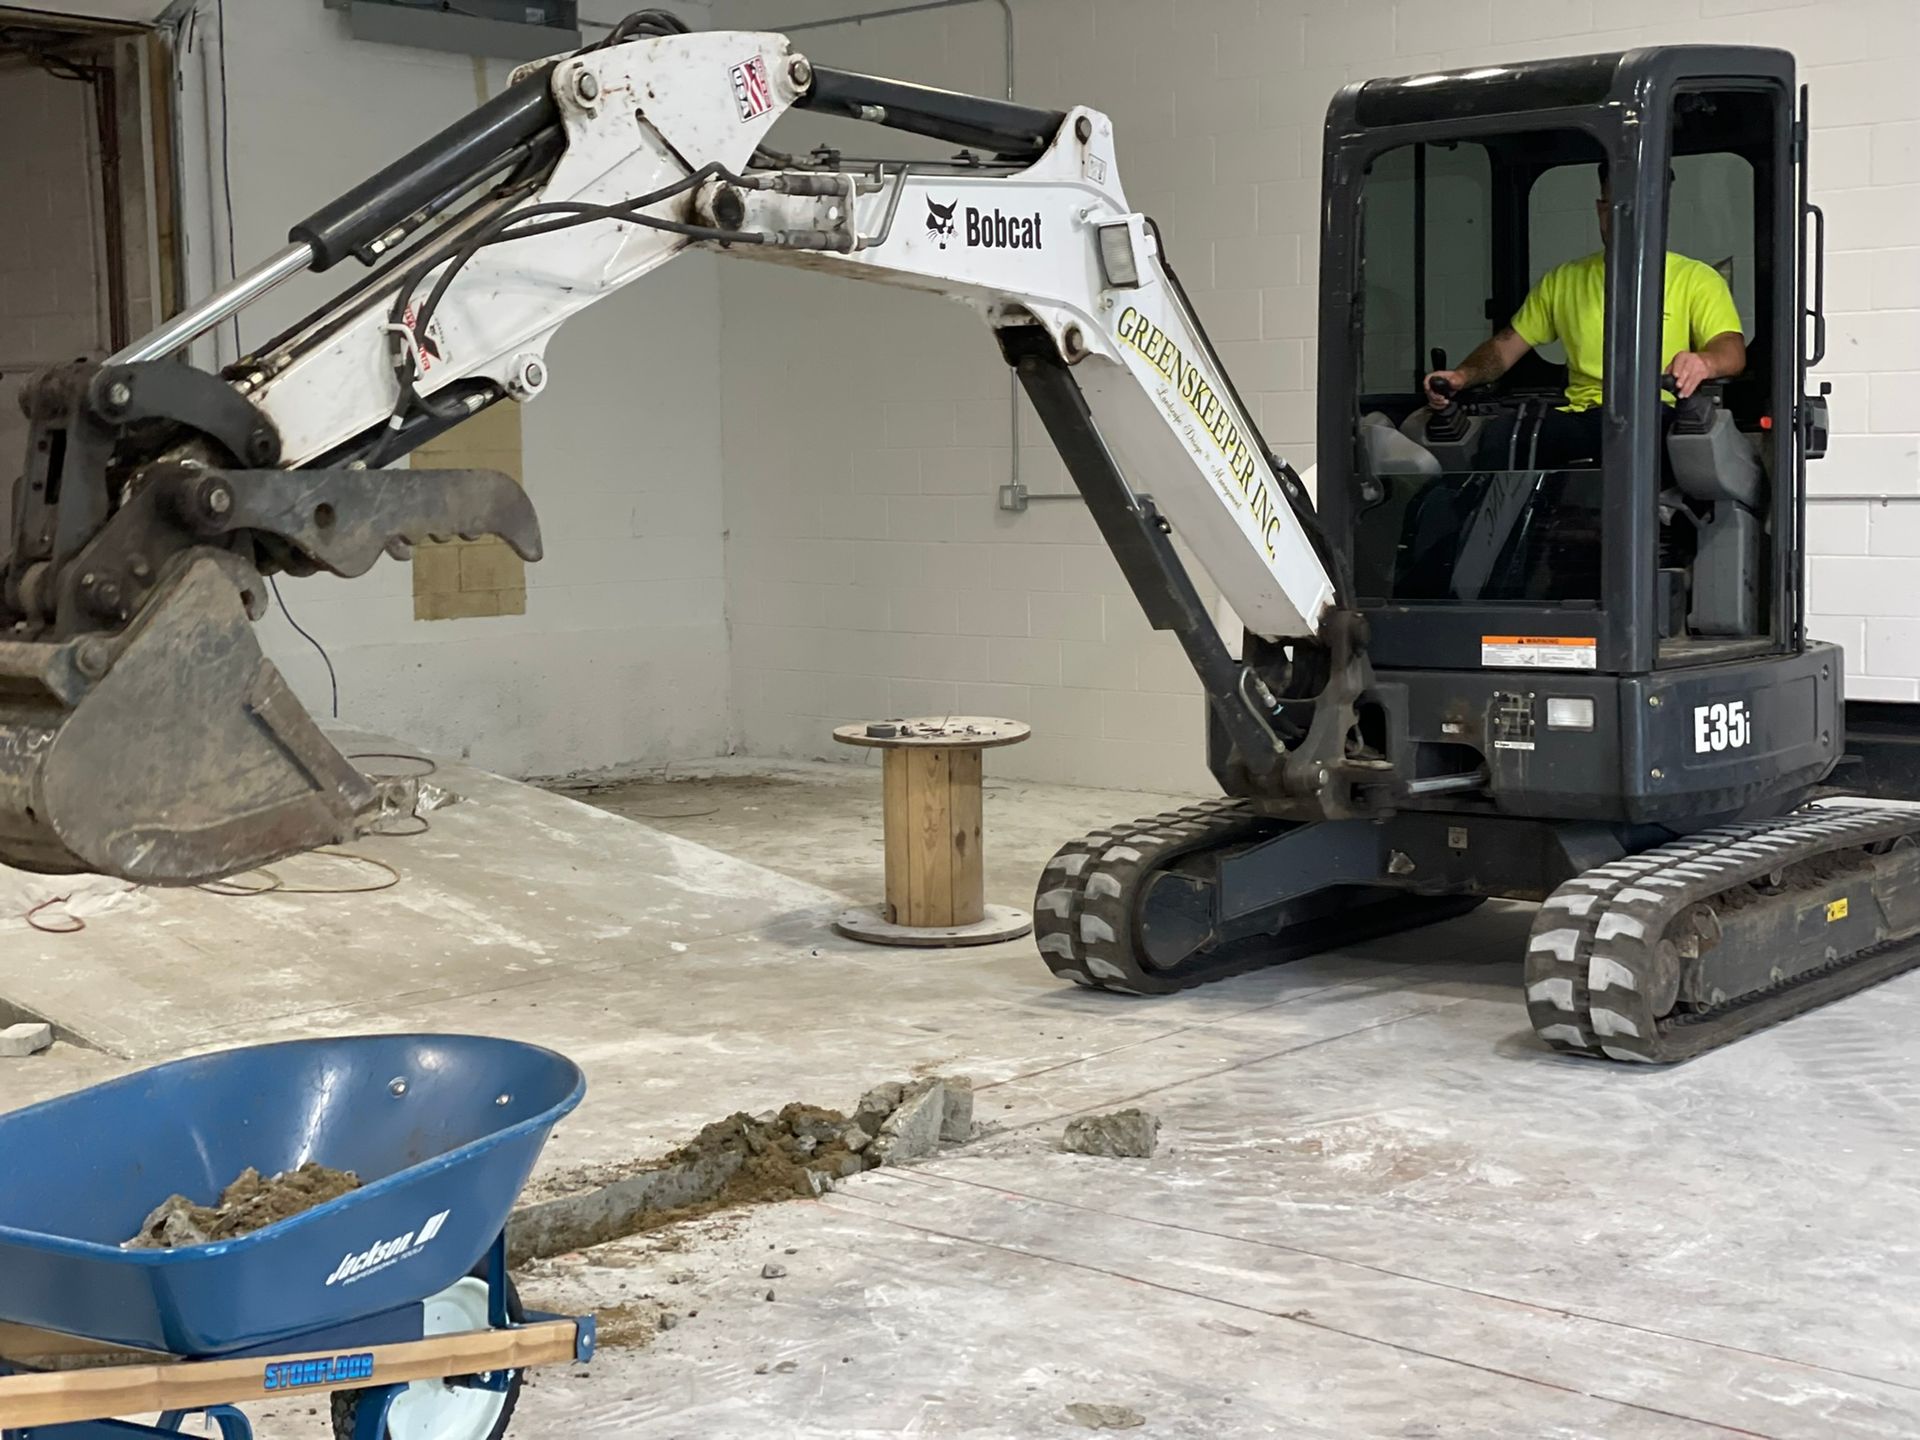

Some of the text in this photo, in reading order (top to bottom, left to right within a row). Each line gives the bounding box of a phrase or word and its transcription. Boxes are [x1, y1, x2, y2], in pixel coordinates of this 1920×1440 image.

[965, 207, 1042, 249] Bobcat
[1116, 306, 1281, 561] GREENSKEEPER INC.
[1694, 700, 1750, 753] E35i
[325, 1231, 415, 1286] Jackson
